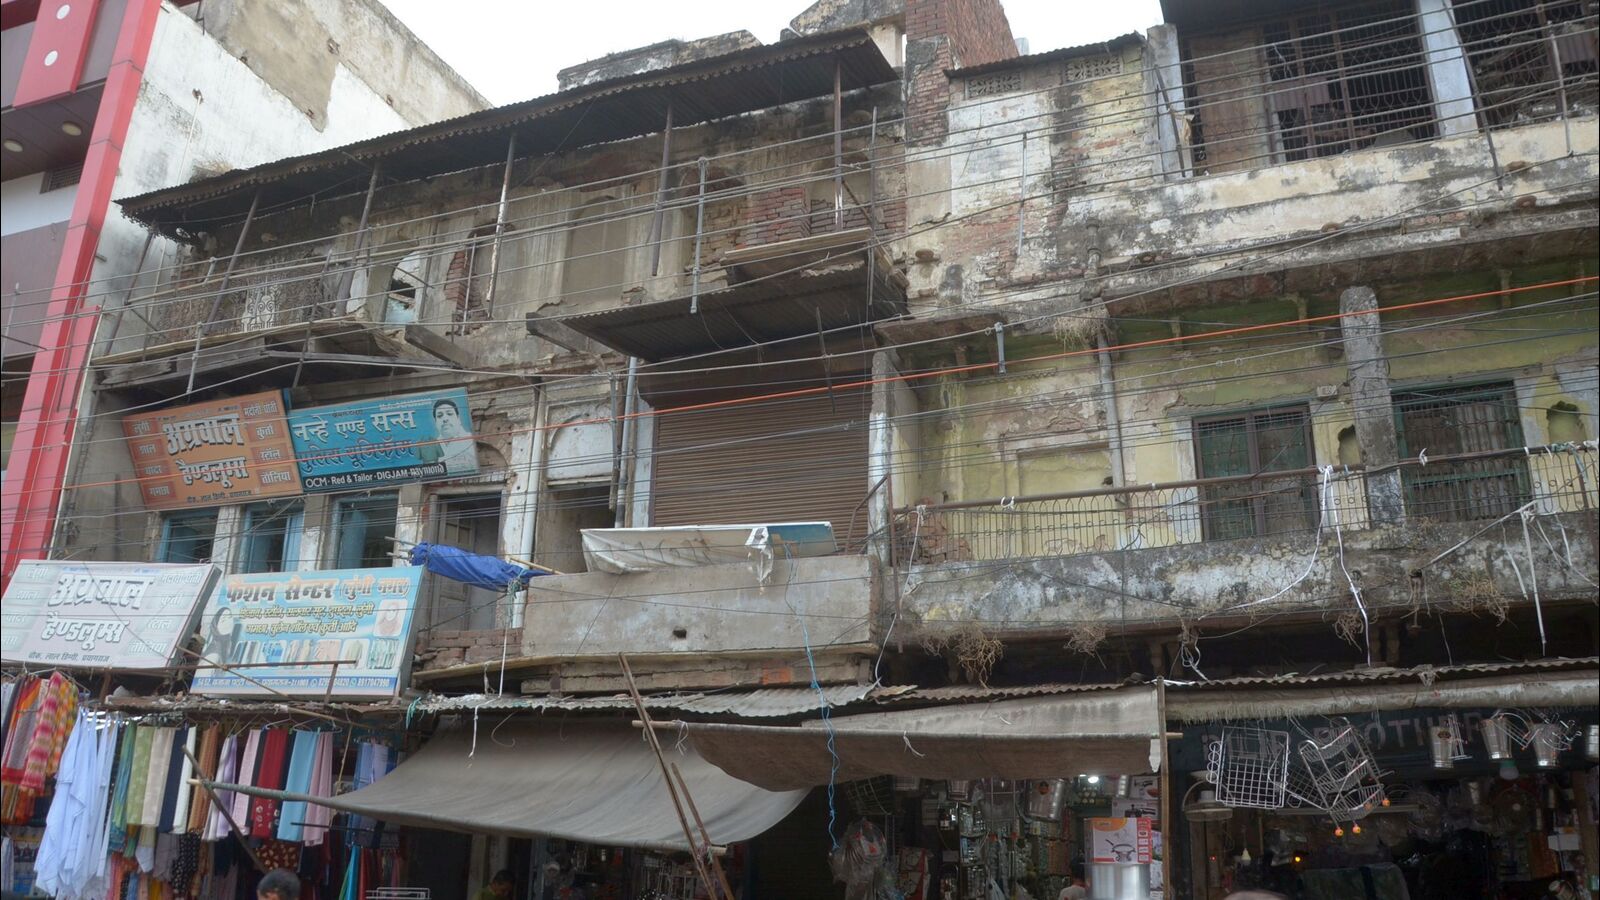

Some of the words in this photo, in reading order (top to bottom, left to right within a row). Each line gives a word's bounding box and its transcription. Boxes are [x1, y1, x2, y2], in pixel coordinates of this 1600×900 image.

[161, 413, 245, 455] अग्रवाल
[334, 418, 367, 439] एण्ड
[370, 408, 417, 433] सन्स
[305, 477, 327, 488] OCM
[331, 475, 345, 485] Red
[346, 474, 352, 483] &
[353, 472, 373, 483] Tailor
[48, 573, 155, 610] अग्रवाल
